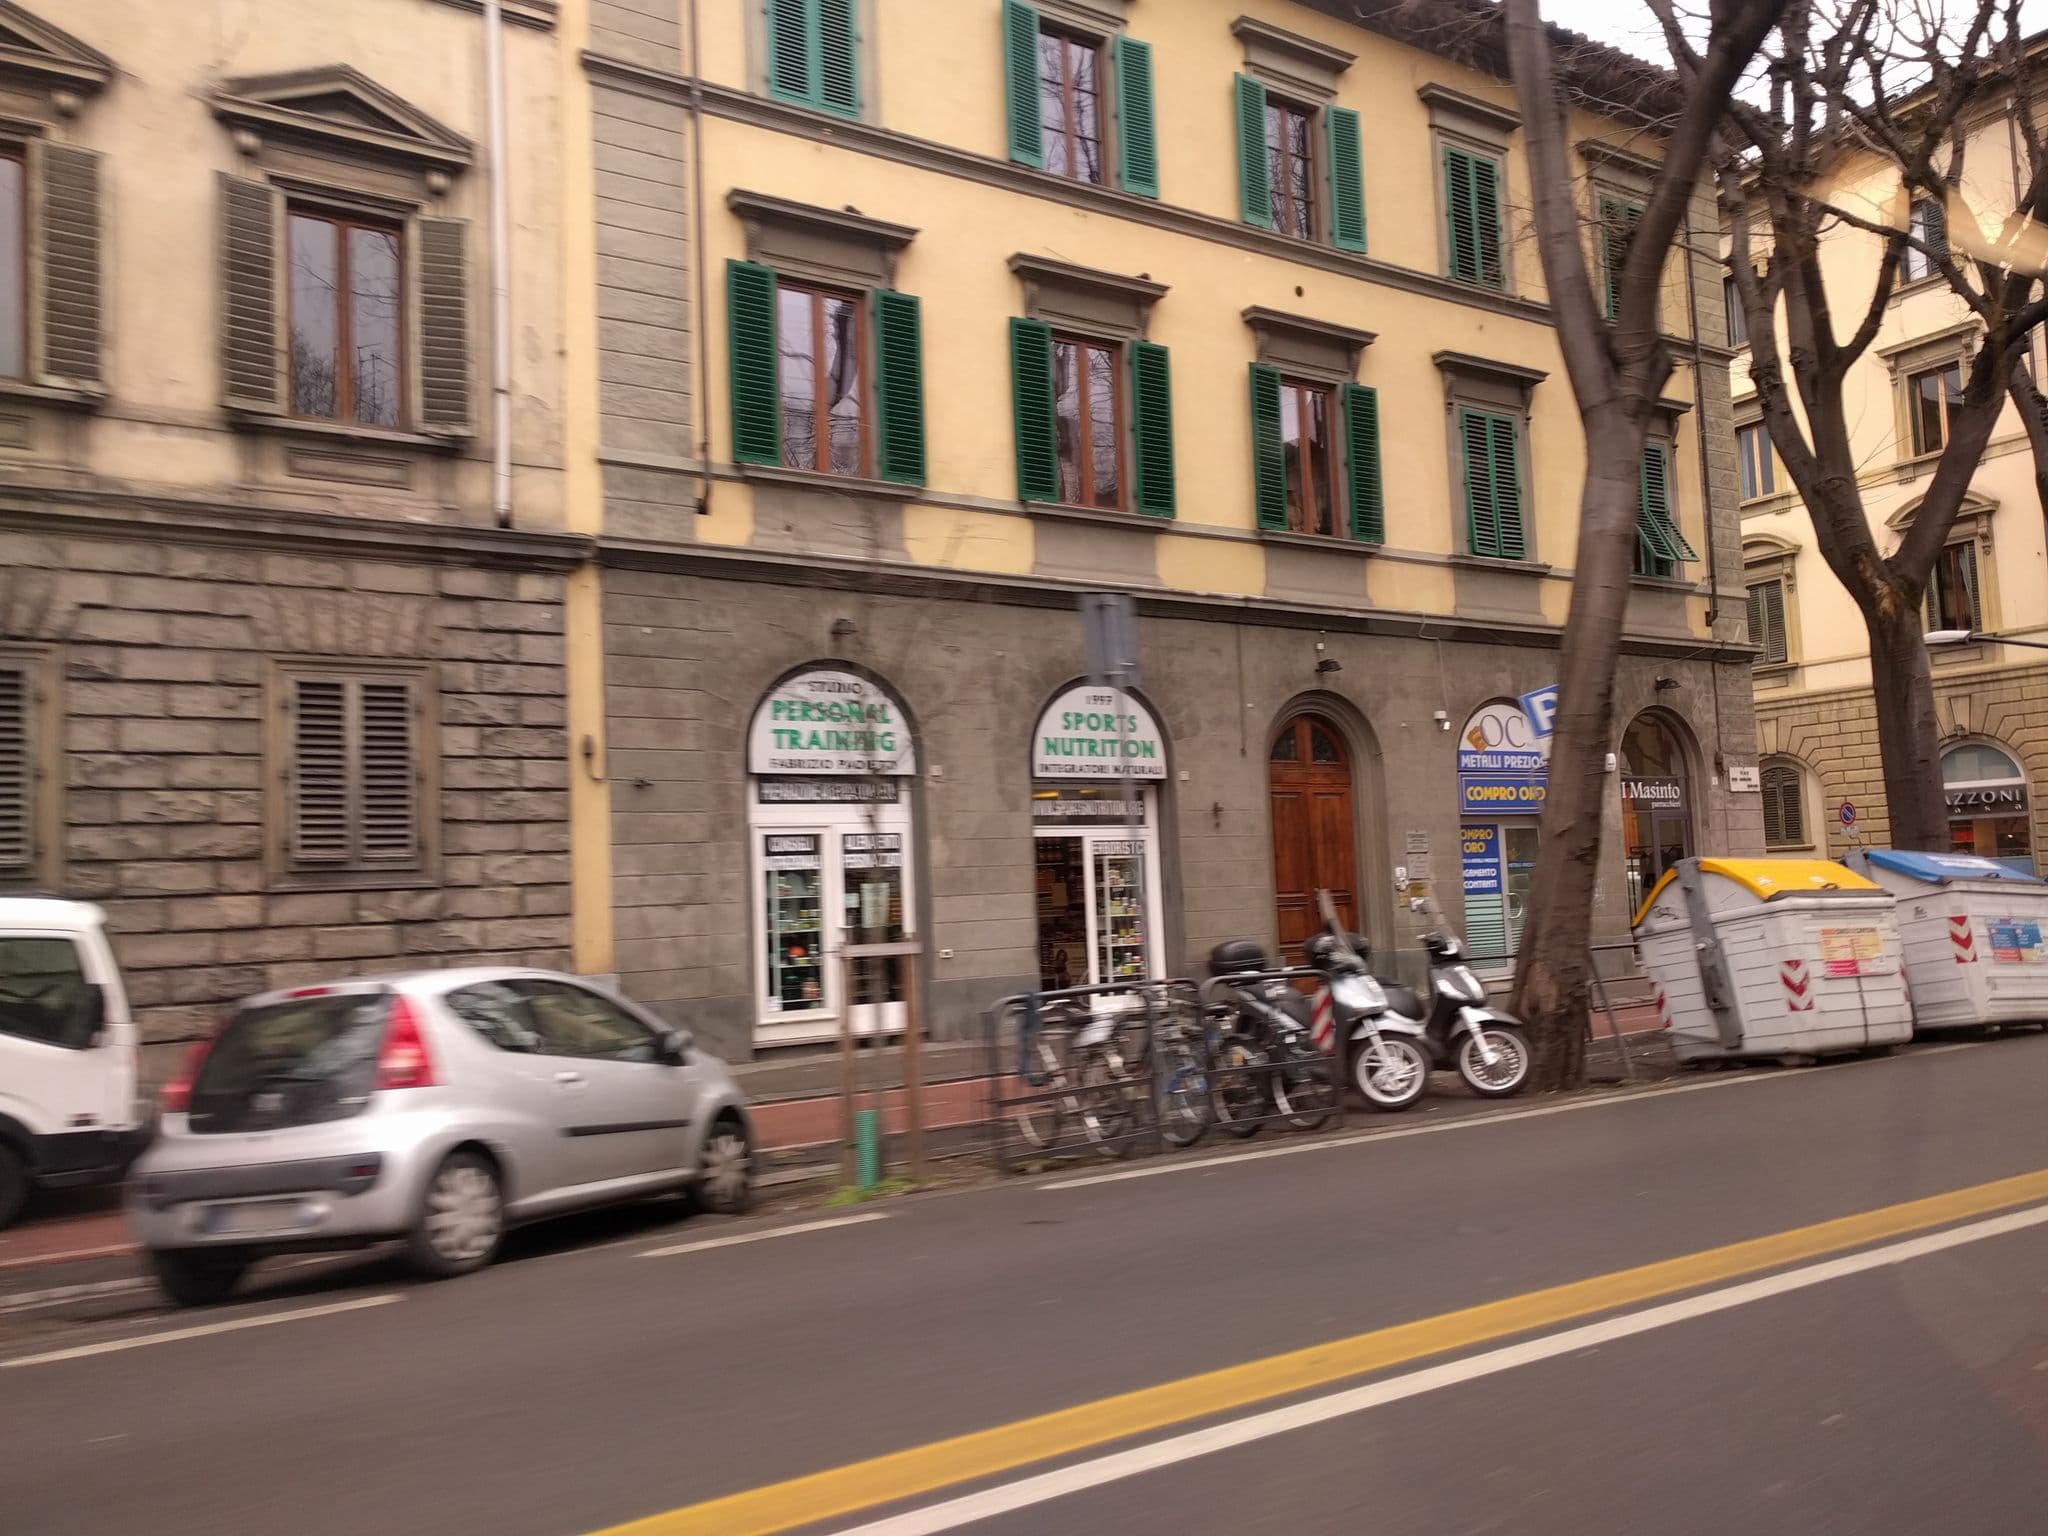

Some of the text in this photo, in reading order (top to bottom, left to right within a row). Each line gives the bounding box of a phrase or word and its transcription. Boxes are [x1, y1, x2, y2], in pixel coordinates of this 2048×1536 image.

[771, 700, 892, 724] PERSONAL
[1061, 711, 1137, 733] SPORTS
[771, 727, 896, 752] TRAINING
[1043, 736, 1157, 759] NUTRITION
[1039, 762, 1163, 776] INTEGRATORI NATURALI
[1460, 753, 1547, 769] METALLI PREZIOS
[1466, 786, 1547, 801] COMPRO ORO
[1629, 781, 1680, 799] Masinto
[1460, 828, 1493, 840] OMPRO
[1463, 842, 1486, 853] ORO
